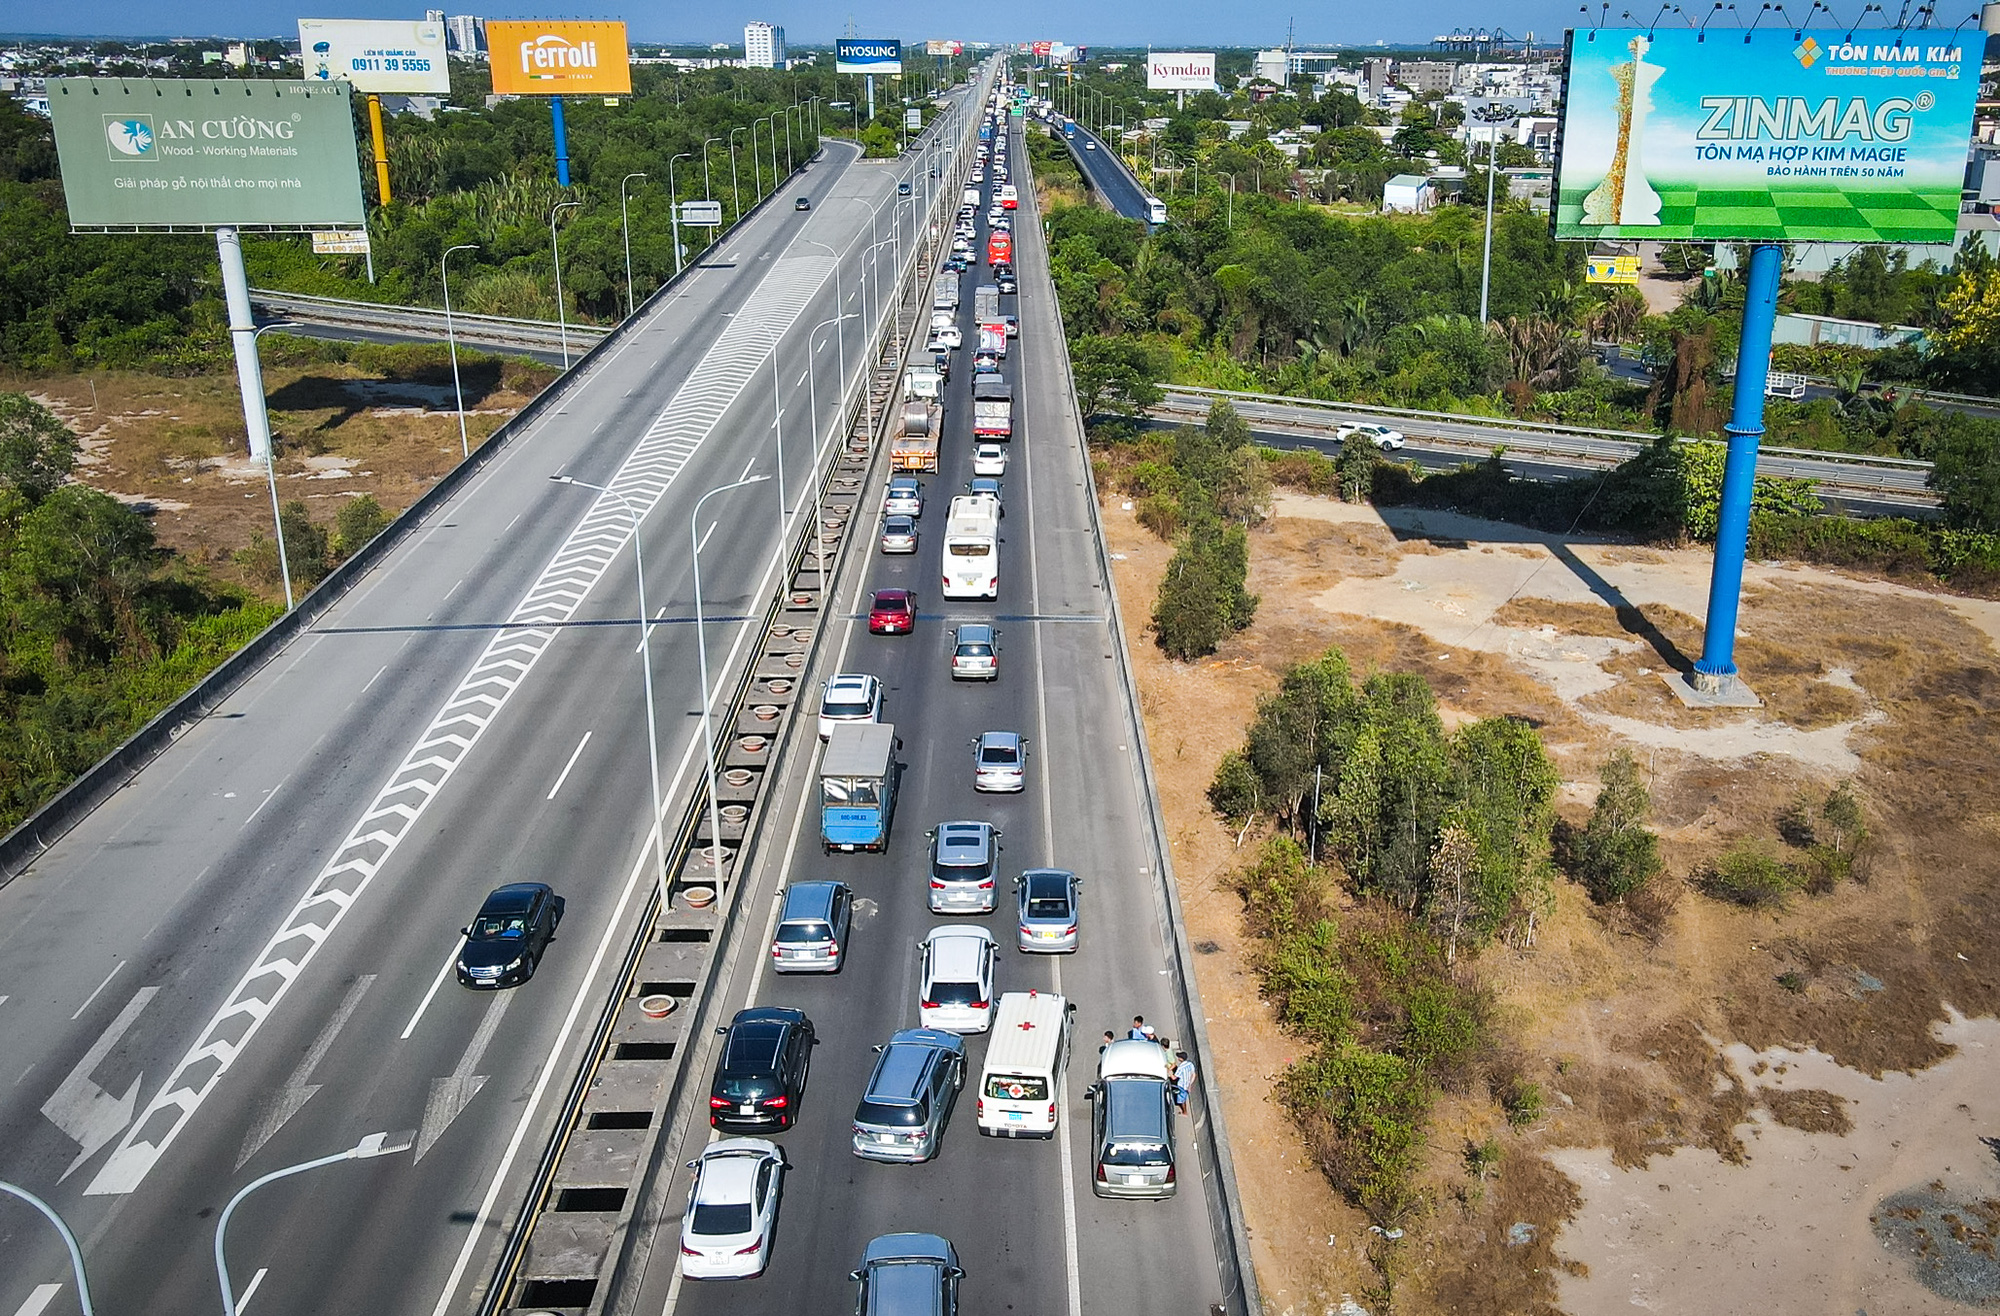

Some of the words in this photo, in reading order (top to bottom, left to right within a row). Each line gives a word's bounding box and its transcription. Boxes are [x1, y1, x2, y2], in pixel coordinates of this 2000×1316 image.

[520, 36, 597, 73] Ferroli
[839, 46, 897, 57] HYOSUNG
[1827, 42, 1868, 61] TÔN
[1873, 45, 1920, 62] NAM
[352, 58, 380, 71] 0911
[384, 58, 399, 71] 39
[402, 58, 431, 71] 5555
[1153, 62, 1211, 78] Kymdan
[160, 120, 196, 139] AN
[161, 146, 194, 156] Wood
[203, 146, 247, 158] Working
[250, 146, 298, 156] Materials
[1695, 143, 1732, 160] TÔN
[1736, 146, 1765, 163] MẠ
[1768, 145, 1809, 163] HỢP
[1811, 146, 1846, 161] KIM
[1850, 147, 1907, 162] MAGIE
[1794, 165, 1827, 176] HÀNH
[1830, 165, 1859, 176] TRÊN
[1861, 168, 1875, 177] 50
[114, 177, 137, 188] Giải
[140, 177, 169, 190] pháp
[172, 175, 187, 190] gỗ
[190, 177, 209, 190] nội
[234, 178, 255, 188] cho
[258, 178, 278, 190] mọi
[281, 178, 302, 188] nhà
